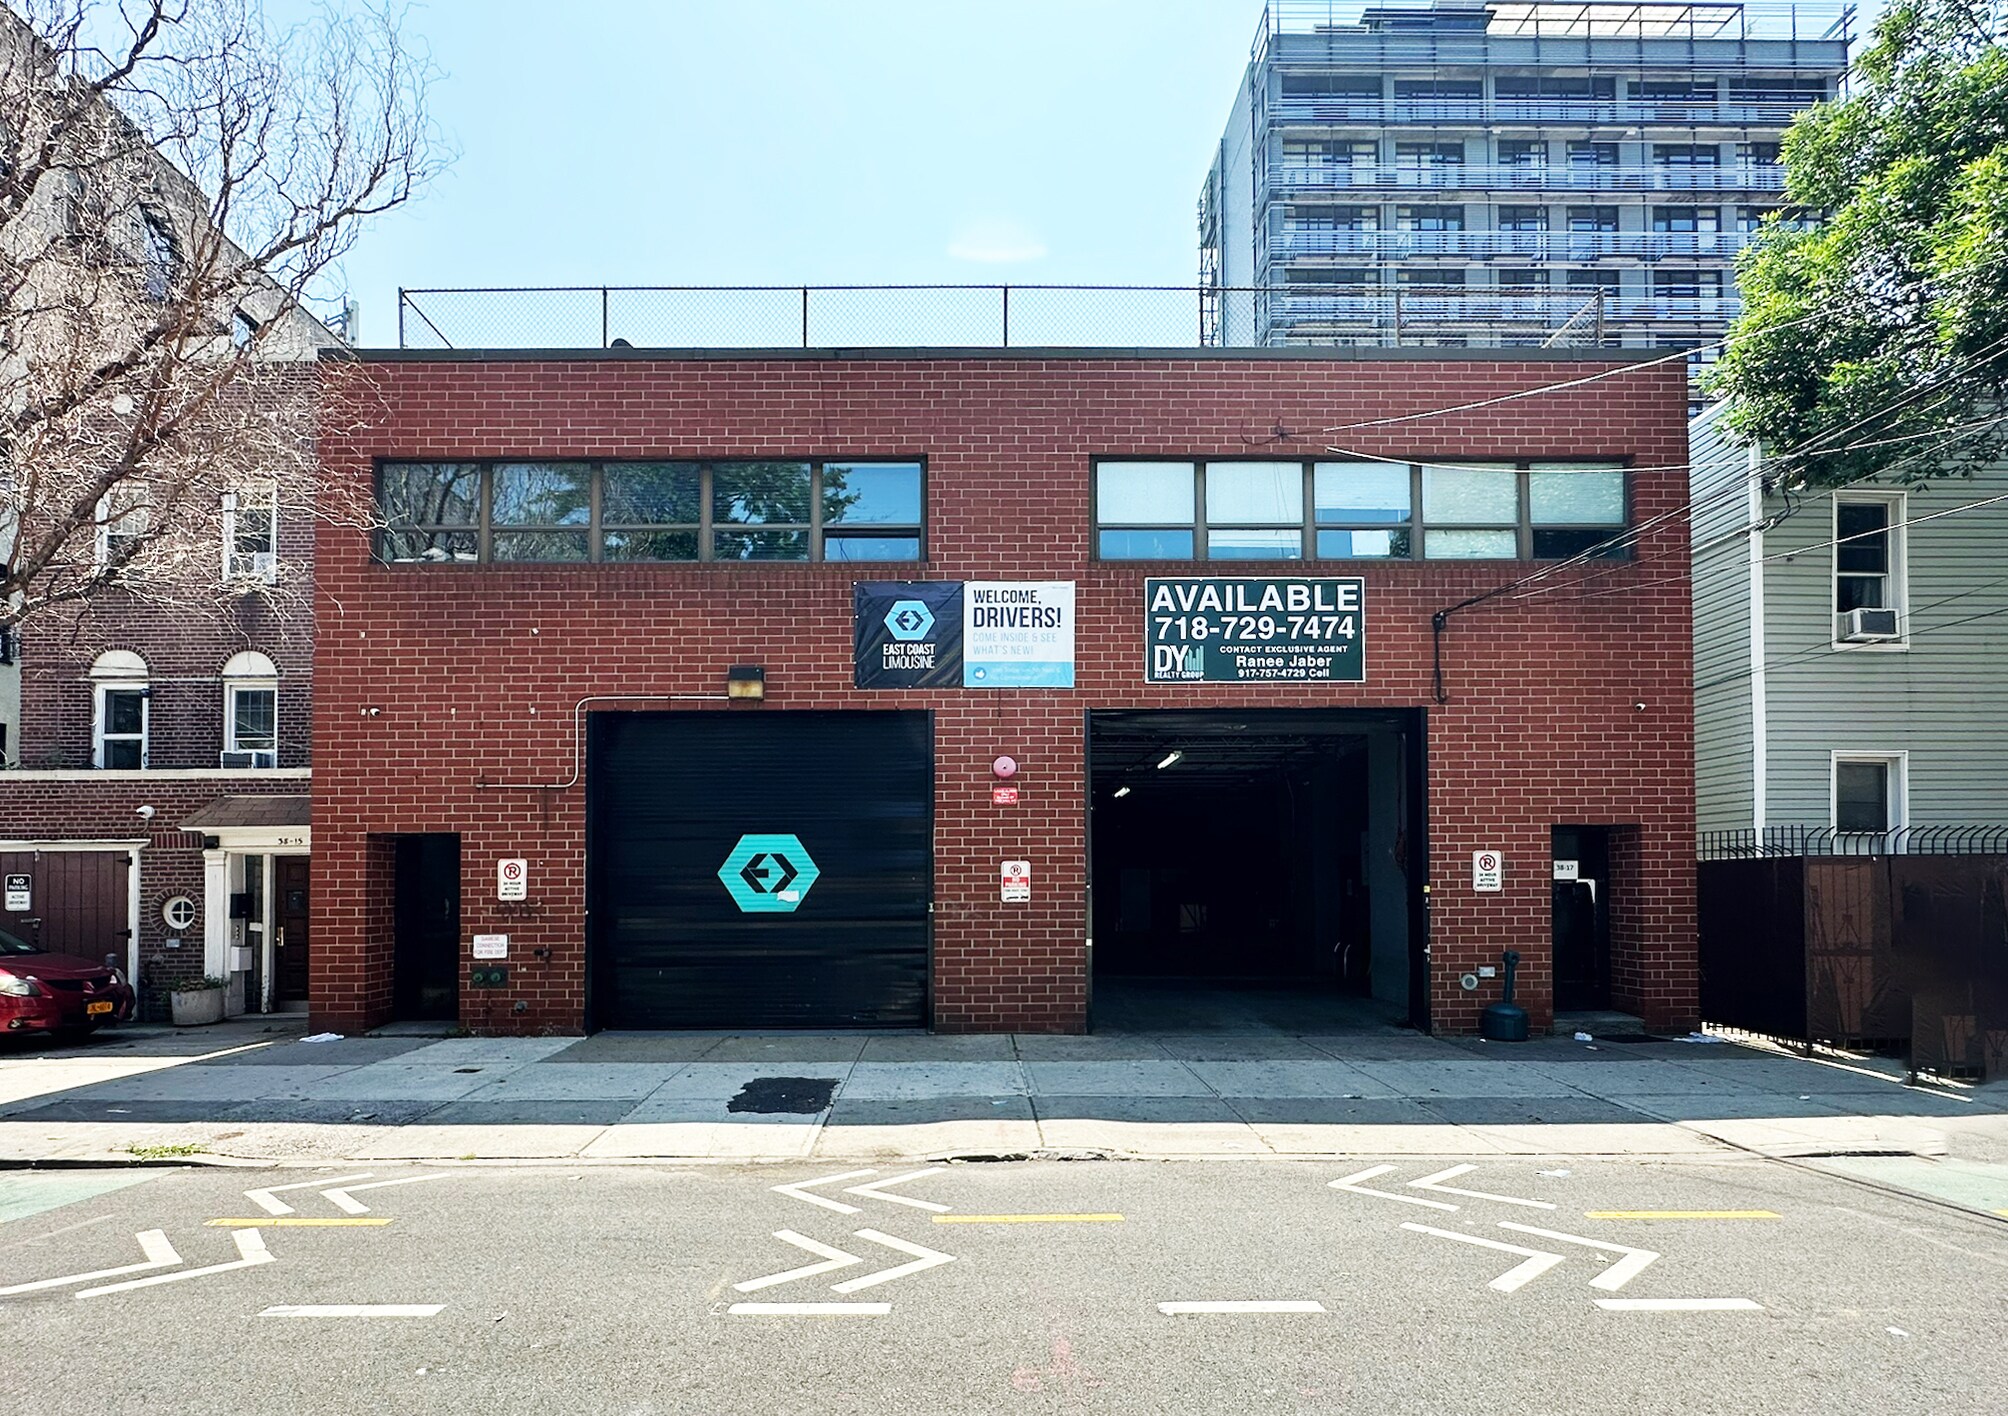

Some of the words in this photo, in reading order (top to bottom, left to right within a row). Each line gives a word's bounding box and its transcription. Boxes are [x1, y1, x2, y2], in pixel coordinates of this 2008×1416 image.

[973, 589, 1042, 605] WELCOME,
[1151, 584, 1359, 612] AVAILABLE
[973, 606, 1062, 628] DRIVERS!
[1154, 615, 1356, 640] 718-729-7474
[973, 632, 998, 643] COME
[1000, 632, 1030, 643] INSIDE
[1032, 632, 1038, 643] &
[1040, 632, 1058, 643] SEE
[883, 643, 905, 655] EAST
[906, 643, 936, 655] COAST
[973, 645, 1008, 655] WHAT'S
[1010, 645, 1034, 655] NEW!
[1219, 645, 1263, 654] CONTACT
[1264, 645, 1315, 654] EXCLUSIVE
[1317, 645, 1348, 654] AGENT
[883, 655, 936, 670] LIMOUSINE
[1154, 644, 1190, 672] DY
[1236, 655, 1284, 668] Ranee
[1288, 655, 1333, 668] Jaber
[1154, 671, 1181, 680] REALTY
[1181, 671, 1205, 680] GROUP
[1238, 668, 1306, 679] 917-757-4729
